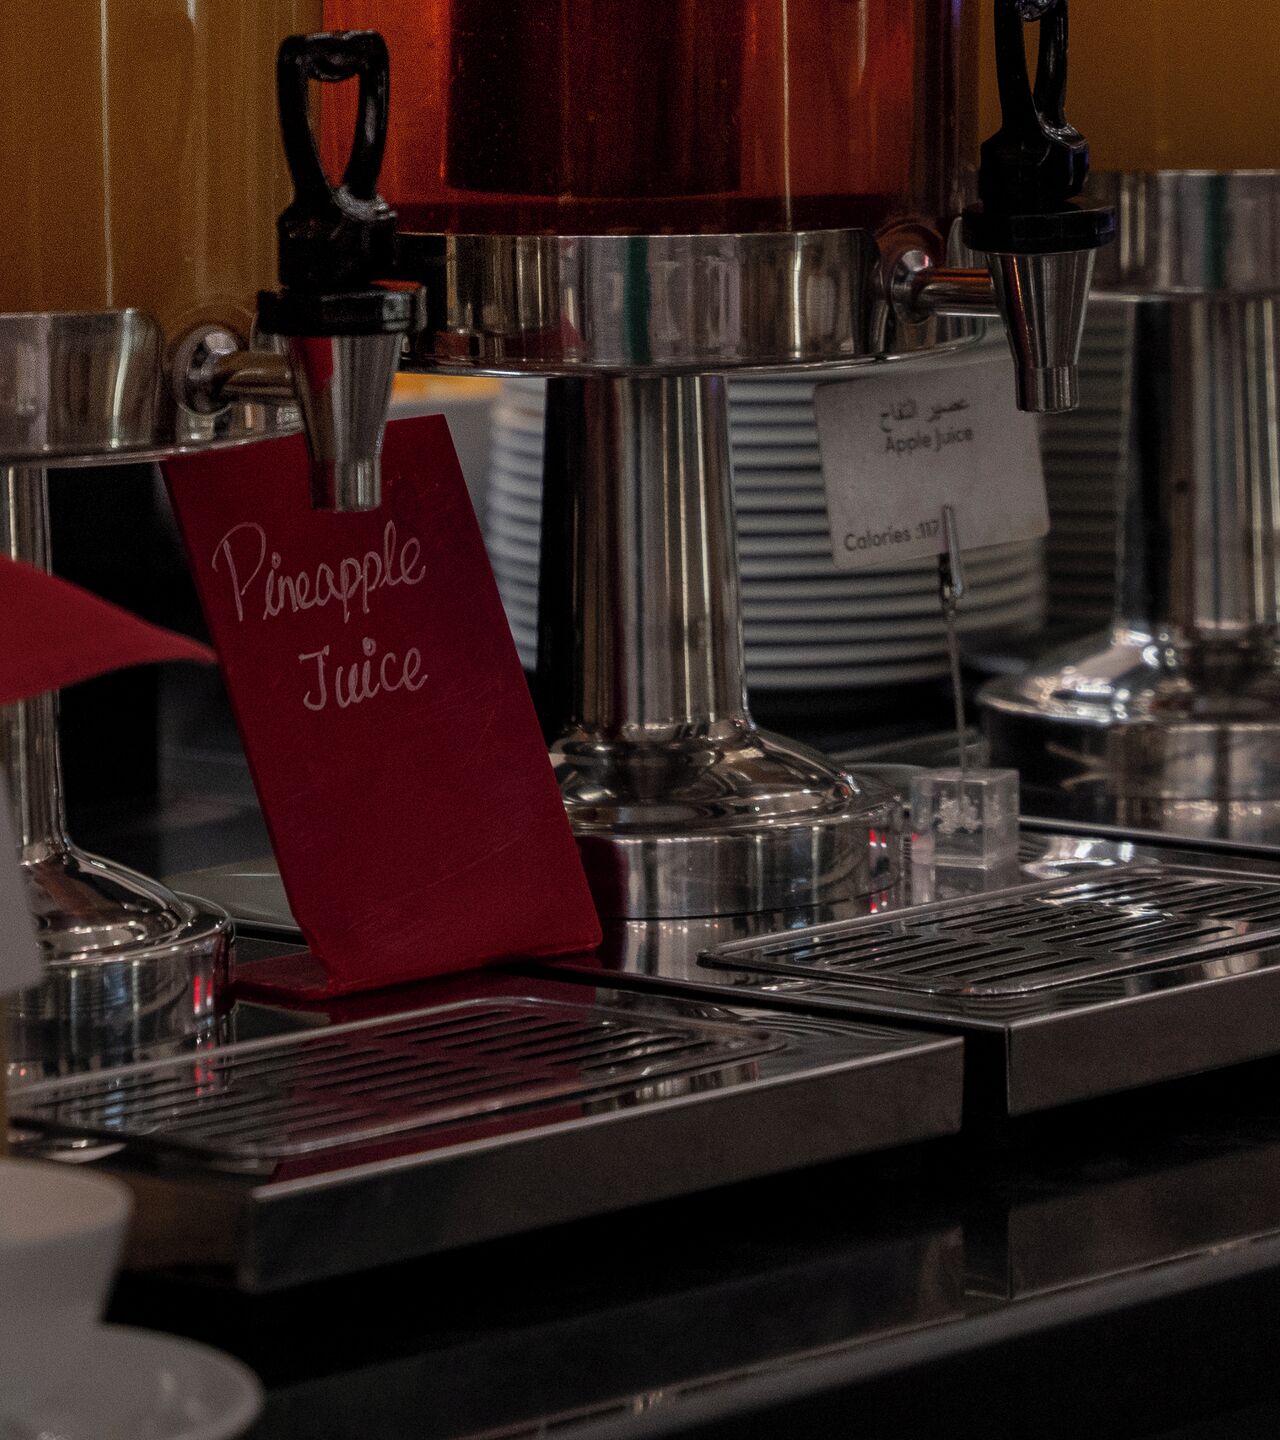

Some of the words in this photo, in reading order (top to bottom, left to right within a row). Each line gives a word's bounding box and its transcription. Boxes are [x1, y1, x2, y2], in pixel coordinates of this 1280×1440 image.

[885, 430, 932, 457] Apple
[935, 426, 974, 452] Juice
[844, 523, 911, 552] Calories
[211, 519, 427, 624] Pineapple
[298, 636, 429, 711] Juice
